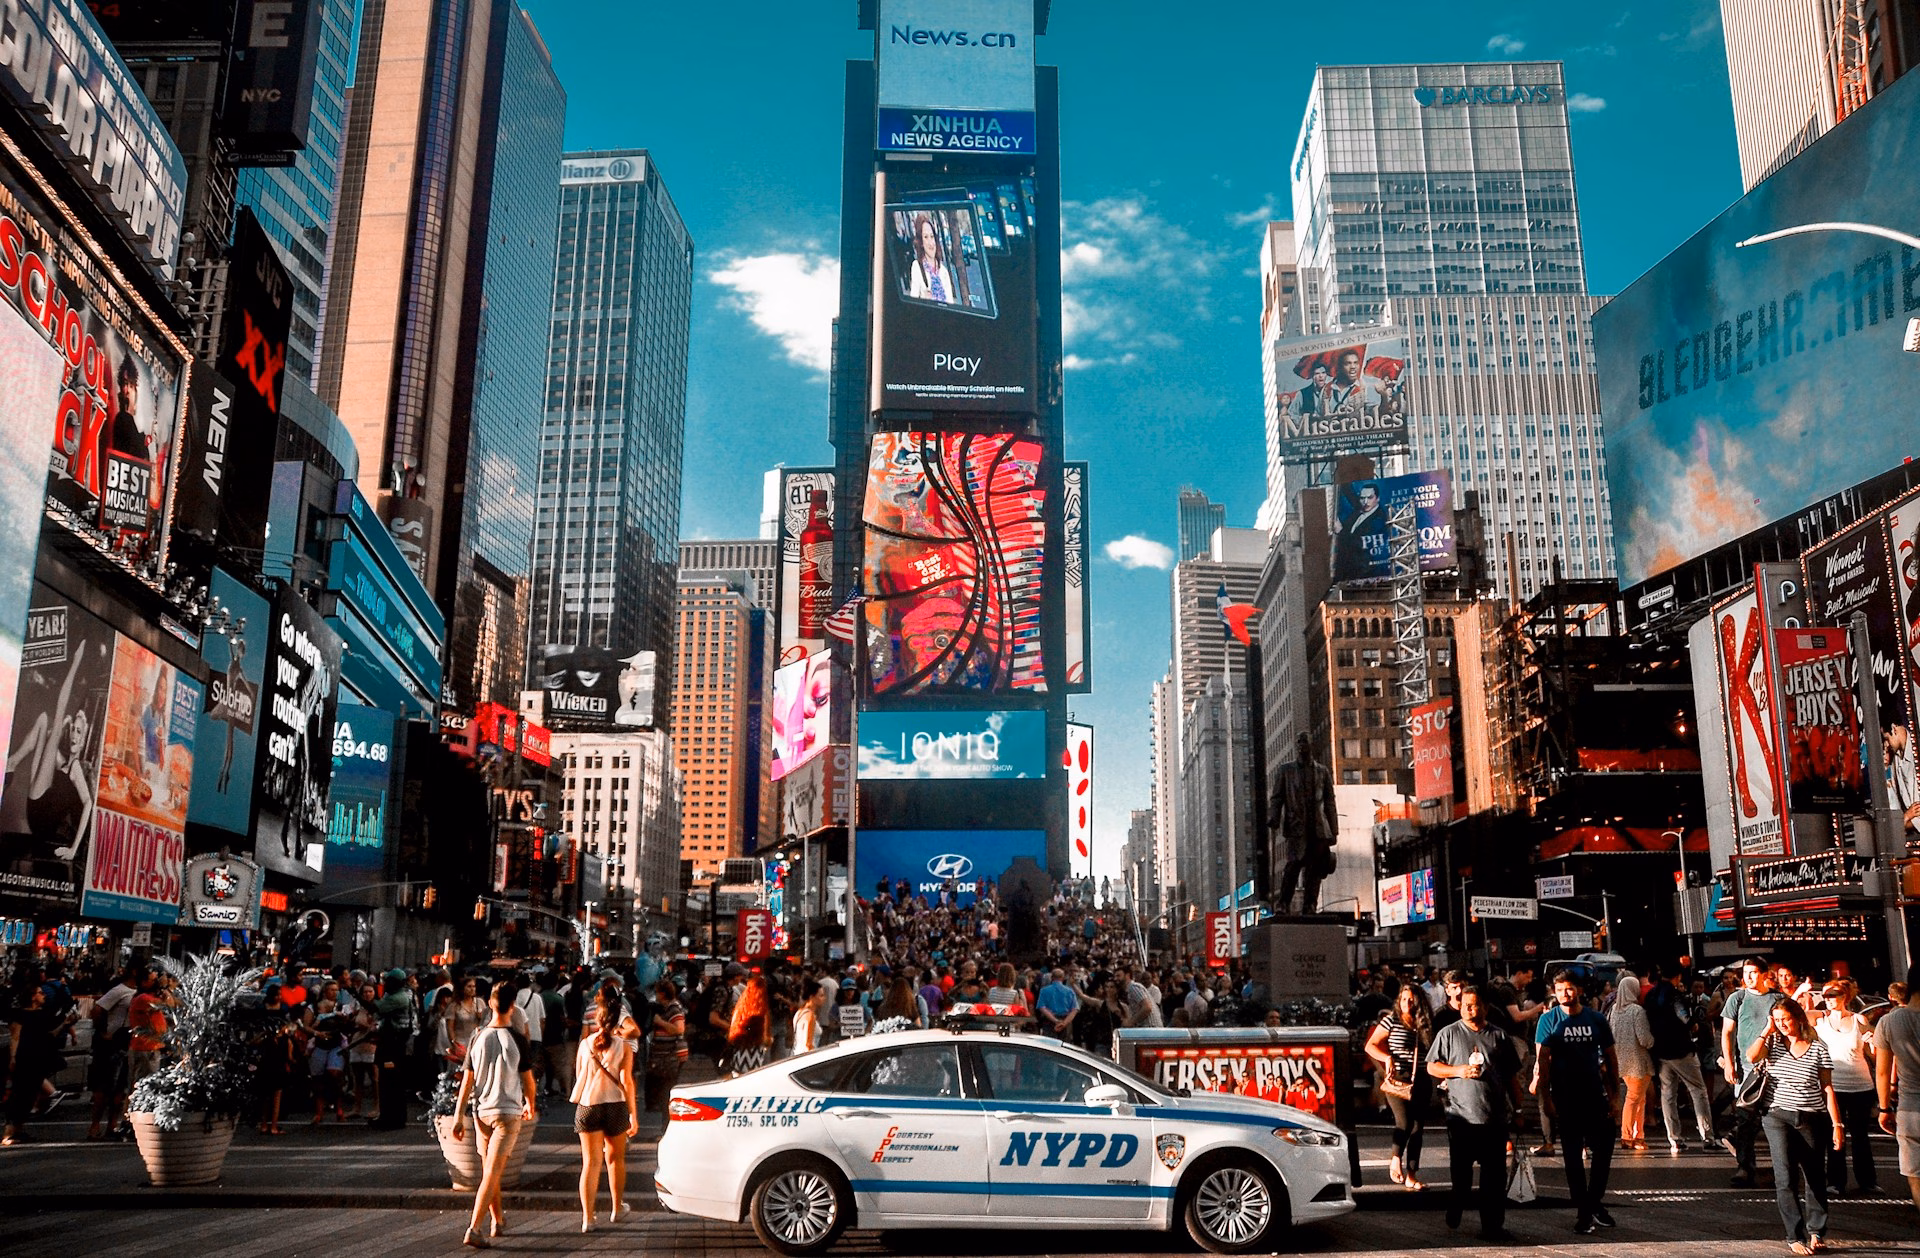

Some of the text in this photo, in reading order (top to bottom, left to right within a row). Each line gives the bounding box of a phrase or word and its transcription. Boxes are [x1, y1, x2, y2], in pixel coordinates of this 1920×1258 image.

[891, 25, 1016, 48] News.cn
[121, 76, 151, 132] MUSICAL
[241, 88, 282, 103] NYC
[1441, 85, 1550, 105] BARCLAYS
[911, 114, 1003, 134] XINHUA
[99, 73, 147, 159] HEATHER
[145, 141, 183, 218] HEADLEY
[891, 132, 1023, 149] NEWS AGENCY
[92, 115, 178, 282] PURPLE
[58, 226, 132, 322] ANDREW LLOYD WEBBER
[257, 260, 283, 310] JVC
[39, 225, 59, 262] THE
[57, 252, 111, 319] EMPOWERING
[110, 304, 145, 358] MESSAGE
[0, 215, 109, 408] SCHOOL
[1276, 346, 1299, 358] FINAL
[1363, 332, 1376, 342] MIZ
[1378, 327, 1398, 338] OUT!
[933, 353, 982, 377] Play
[886, 383, 907, 391] Watch
[907, 383, 947, 392] Unbreakable
[947, 385, 969, 393] Kimmy
[969, 385, 995, 393] Schmidt
[1004, 386, 1025, 394] Netflix
[1282, 405, 1405, 439] Misérables
[1324, 398, 1355, 417] Les
[203, 387, 232, 496] NEW
[1336, 435, 1365, 443] IMPERIAL
[1366, 432, 1394, 440] THEATRE
[107, 459, 150, 496] BEST
[1391, 484, 1439, 497] LET YOUR
[105, 488, 147, 515] MUSICAL!
[104, 508, 146, 528] TONY AWARD NOMINEE
[921, 562, 940, 577] day
[1825, 536, 1866, 579] Winner!
[1828, 563, 1865, 594] 4 TONY AWARDS
[1823, 596, 1844, 619] Best
[1844, 576, 1880, 606] Musical!
[28, 613, 65, 639] YEARS
[281, 612, 296, 647] Go
[295, 630, 322, 672] where
[276, 655, 300, 690] your
[1785, 655, 1848, 696] JERSEY
[175, 681, 199, 712] BEST
[211, 680, 252, 716] StubHub
[1796, 691, 1844, 727] BOYS
[272, 693, 307, 735] routine
[268, 731, 296, 768] can't.
[901, 731, 999, 761] IONIQ
[991, 763, 1013, 772] SHOW
[1740, 823, 1760, 839] WINNER!
[1763, 820, 1776, 834] TONY
[1762, 834, 1774, 843] BEST
[91, 808, 183, 904] WAITRESS
[1759, 871, 1767, 890] An
[1767, 867, 1799, 889] American
[200, 907, 237, 920] Sanrio
[1474, 899, 1501, 908] PEDESTRIAN
[1501, 900, 1515, 908] FLOW
[1510, 909, 1528, 917] MOVING
[746, 911, 768, 956] tkts
[1214, 915, 1231, 958] tkts
[1563, 1026, 1592, 1037] ANU
[1154, 1056, 1327, 1100] JERSEY BOYS
[723, 1096, 827, 1113] TRAFFIC
[760, 1115, 777, 1128] SPL
[781, 1115, 799, 1128] OPS
[887, 1126, 934, 1140] COURTESY
[871, 1150, 914, 1164] RESPECT
[879, 1139, 959, 1152] PROFESSIONALISM
[999, 1131, 1139, 1168] NYPD
